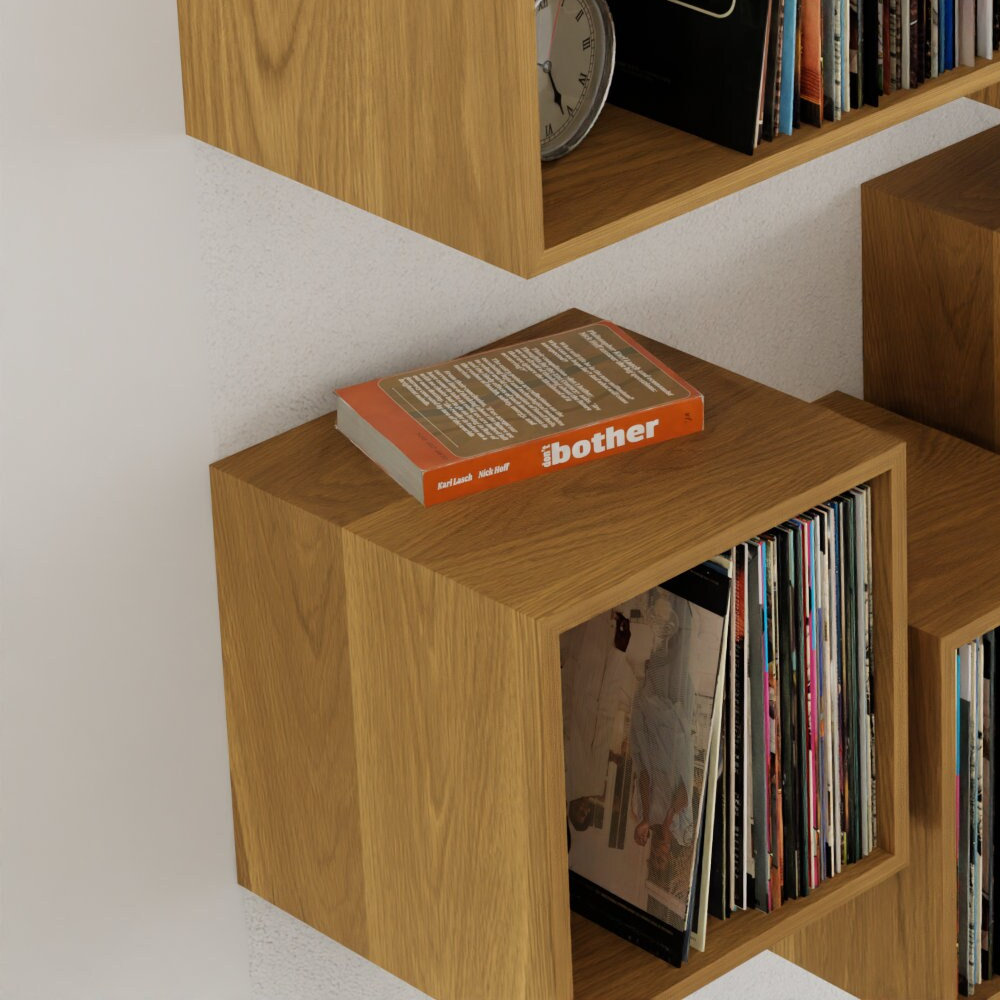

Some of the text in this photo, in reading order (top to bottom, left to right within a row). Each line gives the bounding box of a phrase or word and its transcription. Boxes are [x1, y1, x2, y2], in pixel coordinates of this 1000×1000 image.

[582, 37, 591, 50] III
[551, 418, 659, 466] bother
[437, 462, 510, 490] Karl Lasch Nick Hoff
